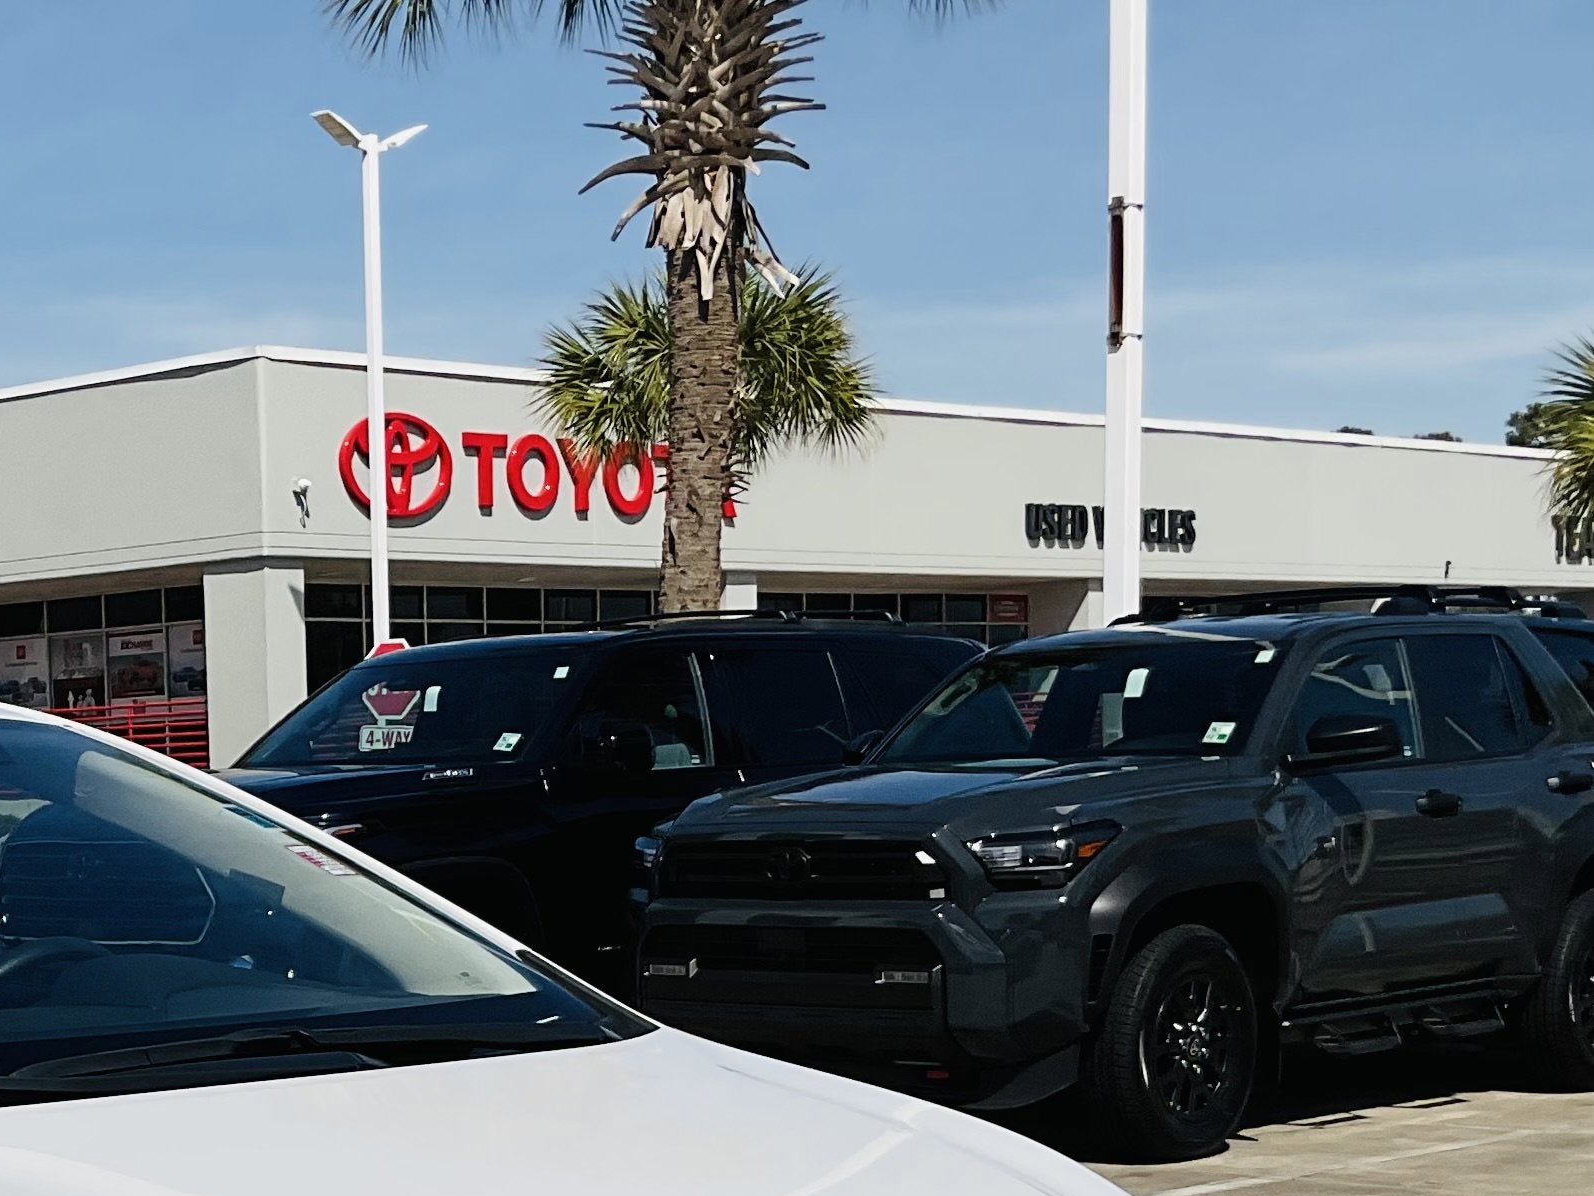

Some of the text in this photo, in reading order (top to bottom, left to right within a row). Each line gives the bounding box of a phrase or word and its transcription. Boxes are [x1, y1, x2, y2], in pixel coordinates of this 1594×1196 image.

[462, 432, 738, 518] TOYO
[1025, 503, 1196, 545] USED VCLES
[366, 730, 411, 747] 4-WAY
